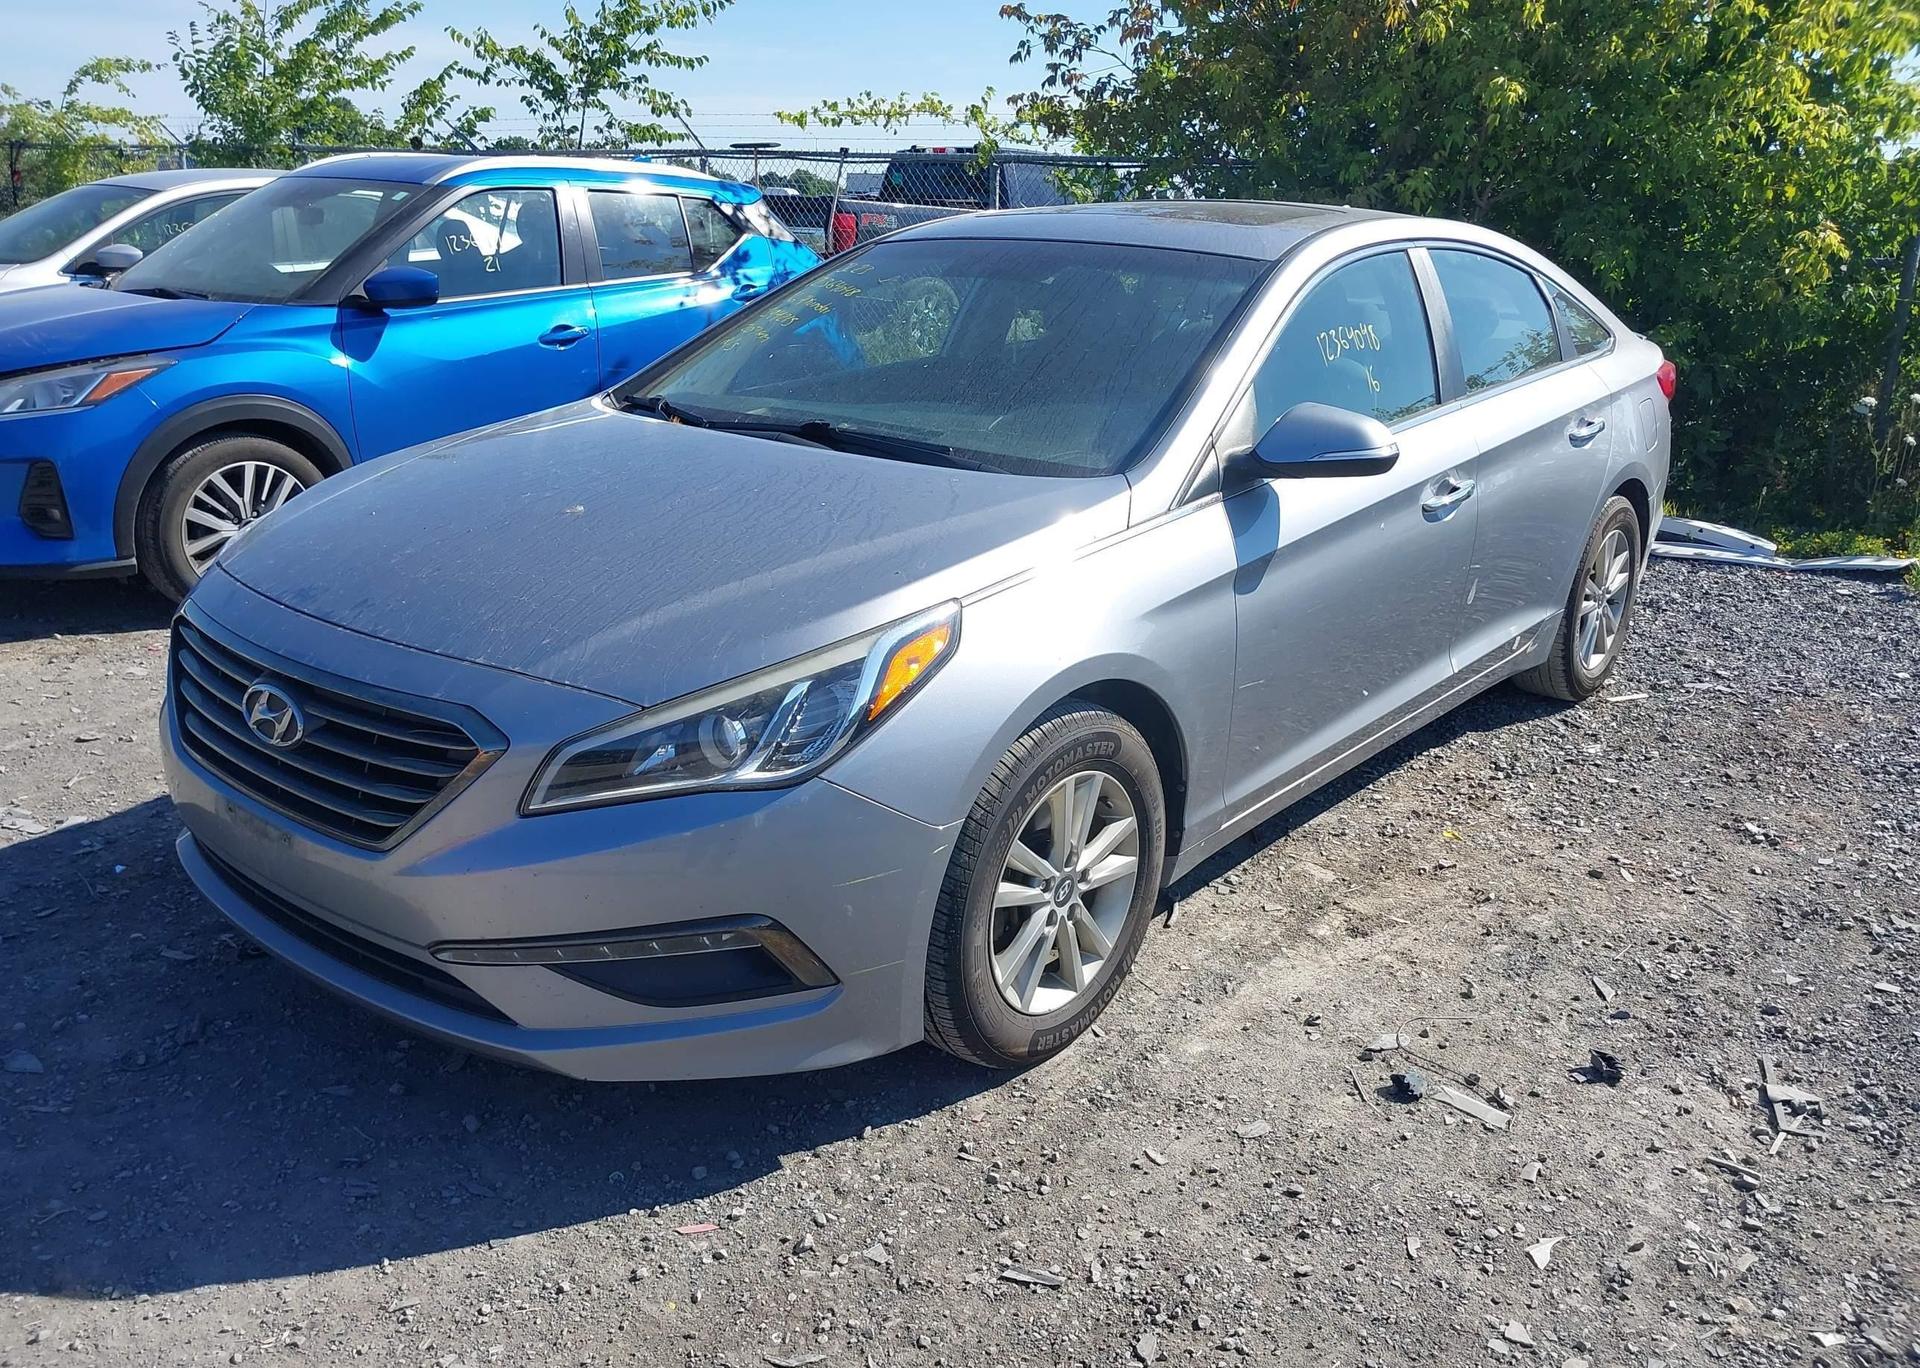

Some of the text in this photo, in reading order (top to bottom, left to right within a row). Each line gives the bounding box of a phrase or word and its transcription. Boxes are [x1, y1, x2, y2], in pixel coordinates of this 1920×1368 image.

[484, 256, 501, 272] 21
[1316, 322, 1380, 367] 12364048
[1365, 364, 1381, 394] 16
[1025, 740, 1116, 804] MOTOMASTER
[1037, 973, 1122, 1051] MOTOMASTER
